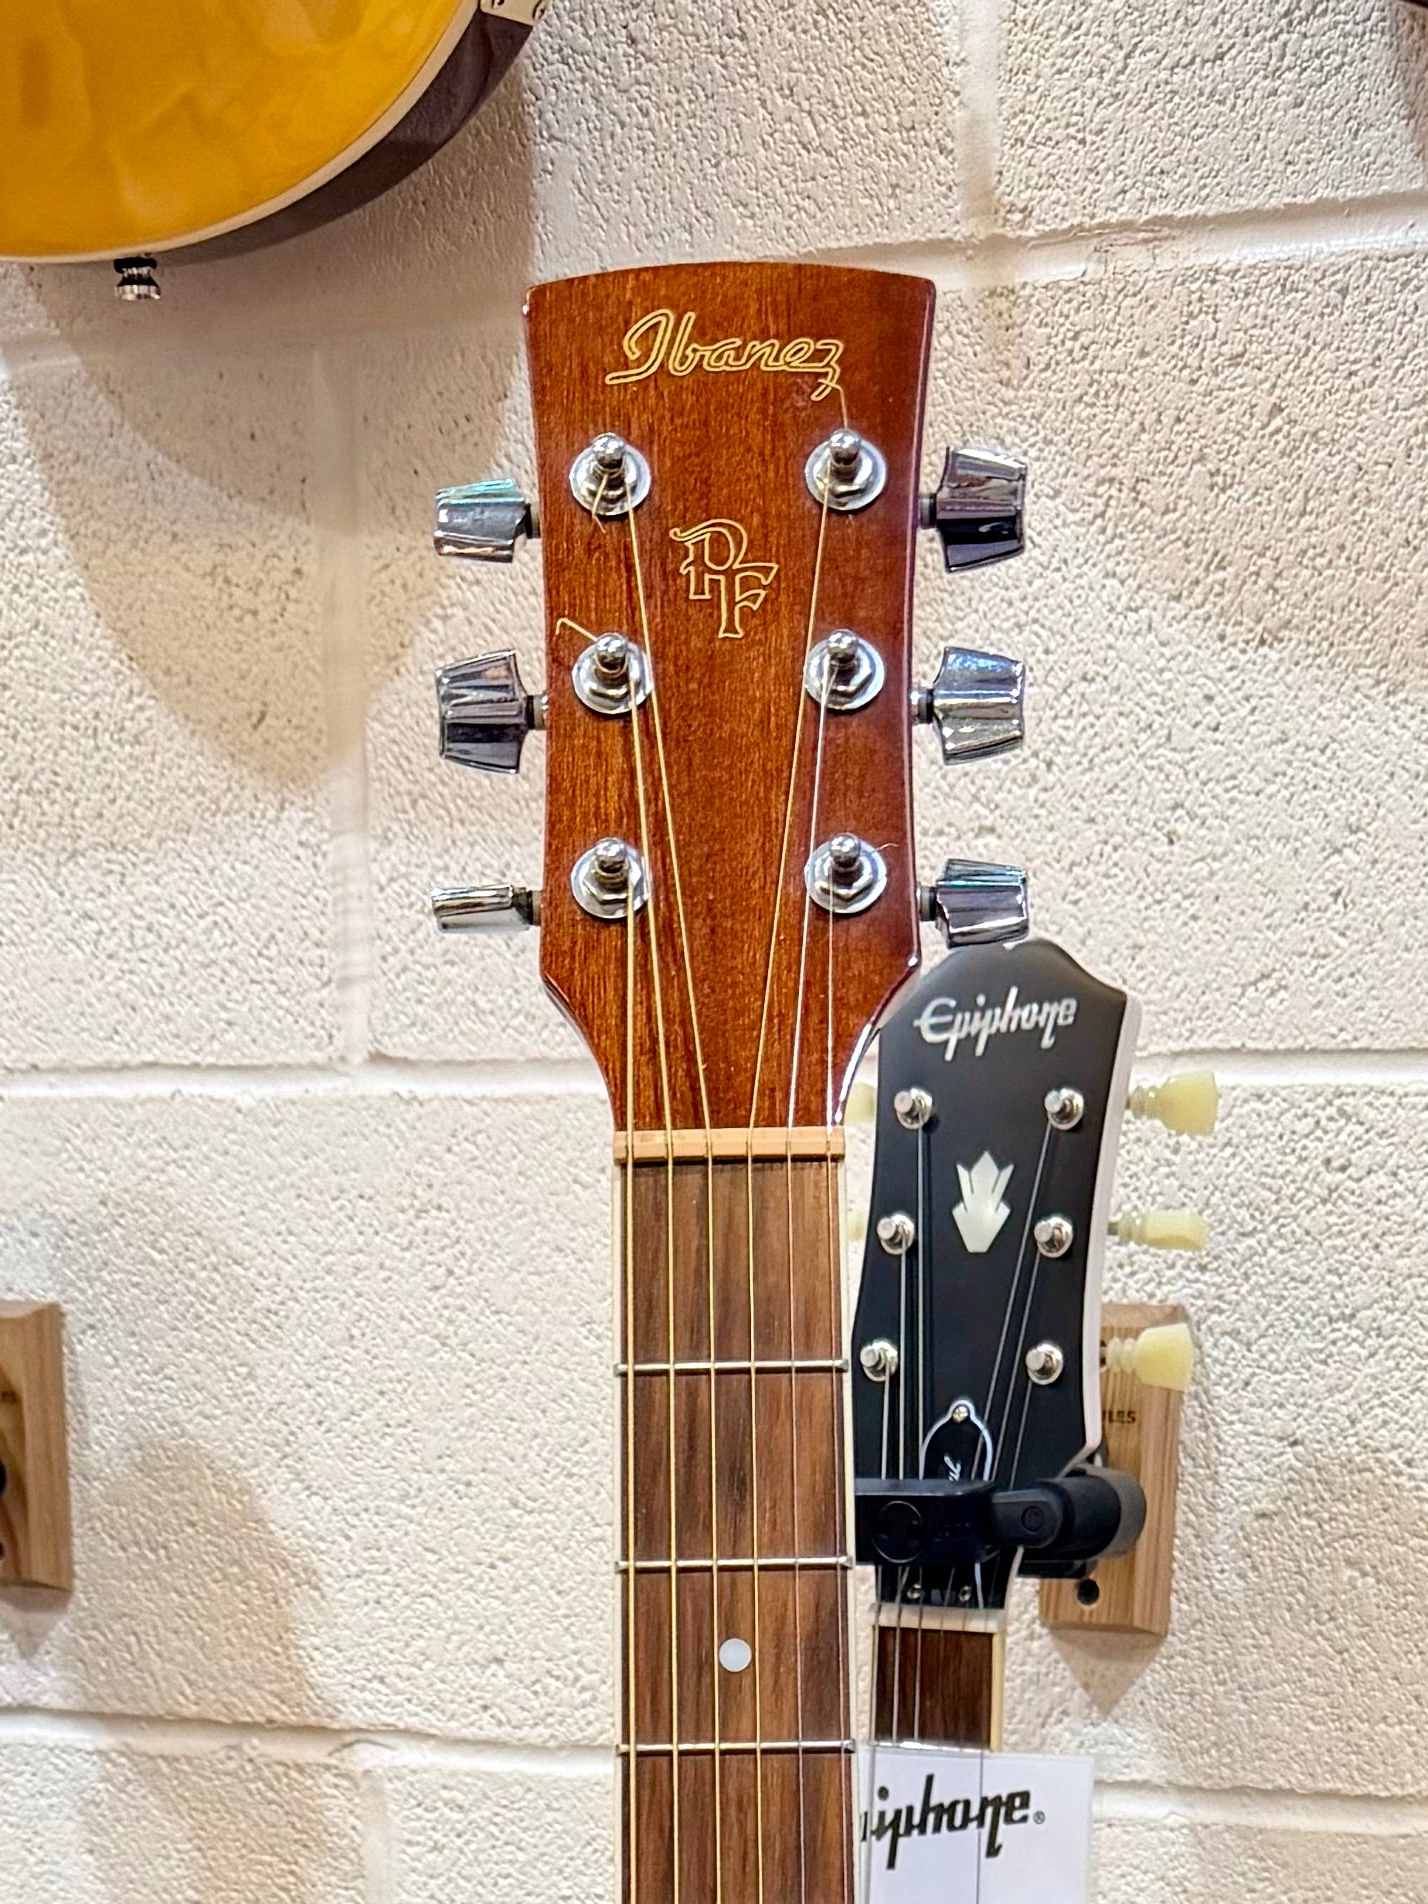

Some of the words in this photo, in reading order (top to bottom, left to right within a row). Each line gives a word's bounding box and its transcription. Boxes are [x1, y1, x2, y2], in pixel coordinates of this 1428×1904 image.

[605, 309, 843, 401] Ibanez
[670, 518, 778, 638] PF
[913, 985, 1078, 1062] Epiphone
[860, 1773, 1033, 1871] iphone
